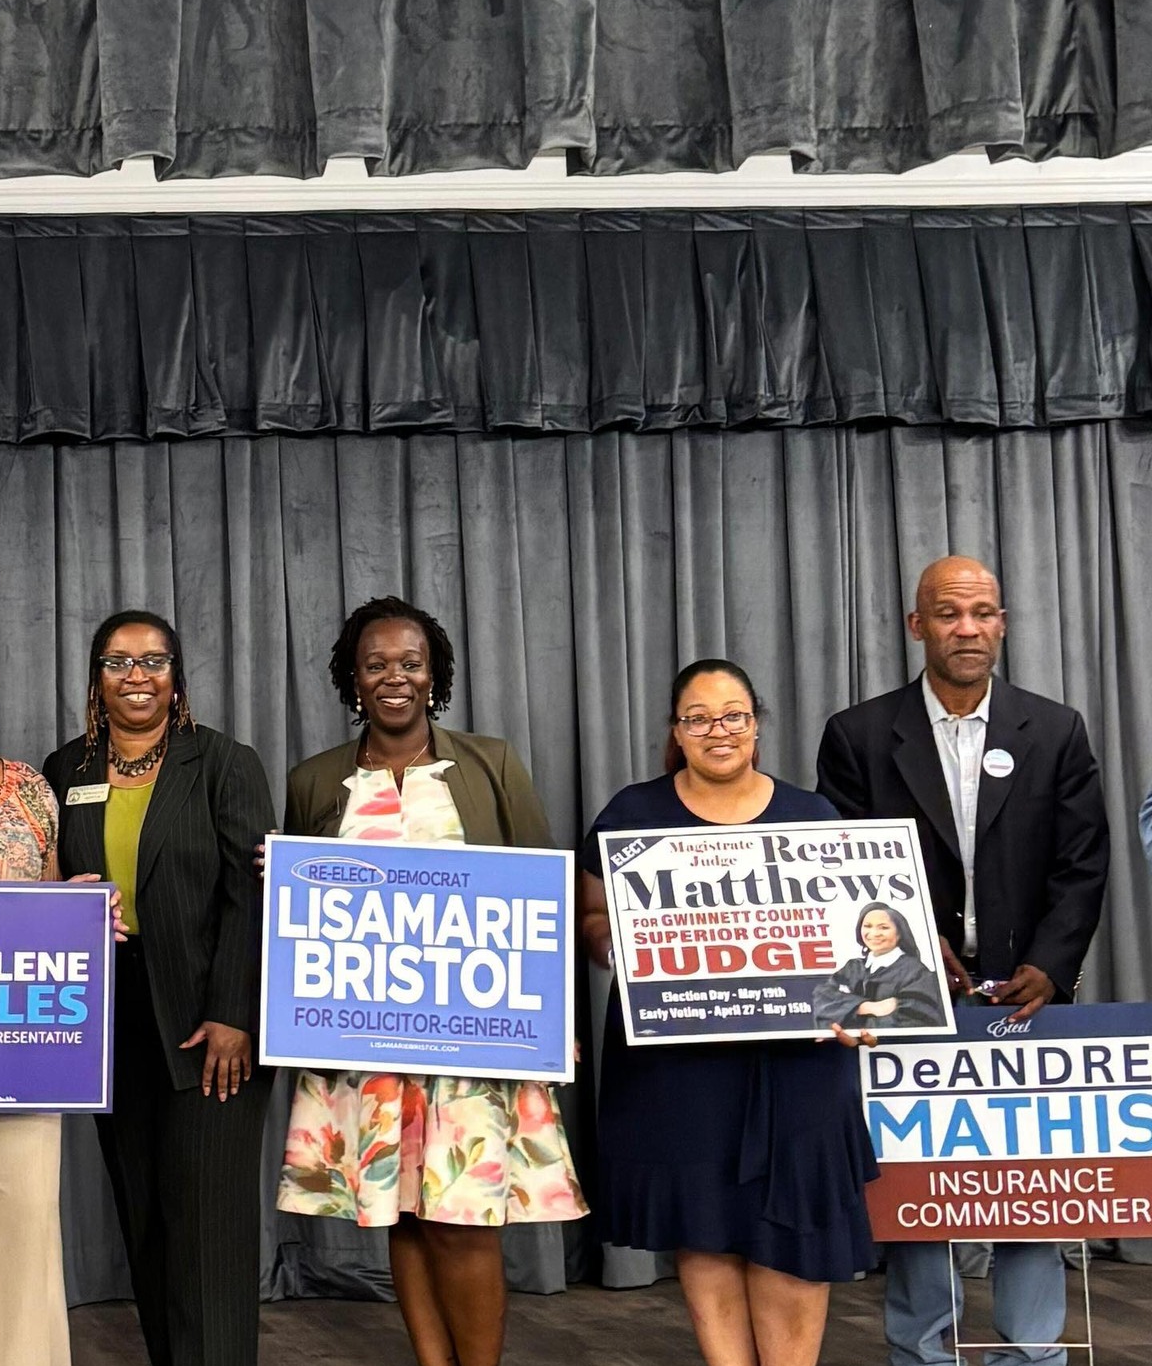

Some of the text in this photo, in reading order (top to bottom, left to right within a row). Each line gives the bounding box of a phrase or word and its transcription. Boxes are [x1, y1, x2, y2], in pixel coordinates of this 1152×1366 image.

[610, 838, 647, 868] ELECT
[669, 839, 753, 854] Magistrate
[689, 855, 737, 867] Judge
[759, 835, 907, 869] Regina
[308, 865, 470, 887] RE-ELECT DEMOCRAT
[620, 865, 915, 912] Matthews
[278, 886, 558, 952] LISAMARIE
[633, 908, 826, 928] FOR GWINNETT COUNTY
[633, 924, 830, 945] SUPERIOR COURT
[633, 941, 837, 977] JUDGE
[293, 939, 542, 1010] BRISTOL
[662, 989, 708, 1003] Election
[709, 989, 730, 1002] Day
[738, 988, 761, 1001] May
[763, 987, 786, 998] 19th
[294, 1008, 537, 1039] FOR SOLICITOR-GENERAL
[639, 1008, 668, 1021] Early
[670, 1007, 706, 1019] Voting
[714, 1004, 741, 1018] April
[742, 1003, 755, 1015] 27
[763, 1004, 786, 1016] May
[788, 1002, 812, 1014] 15th
[370, 1041, 459, 1052] LISAMARIEBRISTOL.COM
[868, 1043, 1152, 1090] DeANDRE
[868, 1093, 1152, 1158] MATHIS
[929, 1167, 1115, 1196] INSURANCE
[898, 1198, 1152, 1228] COMMISSIONER
